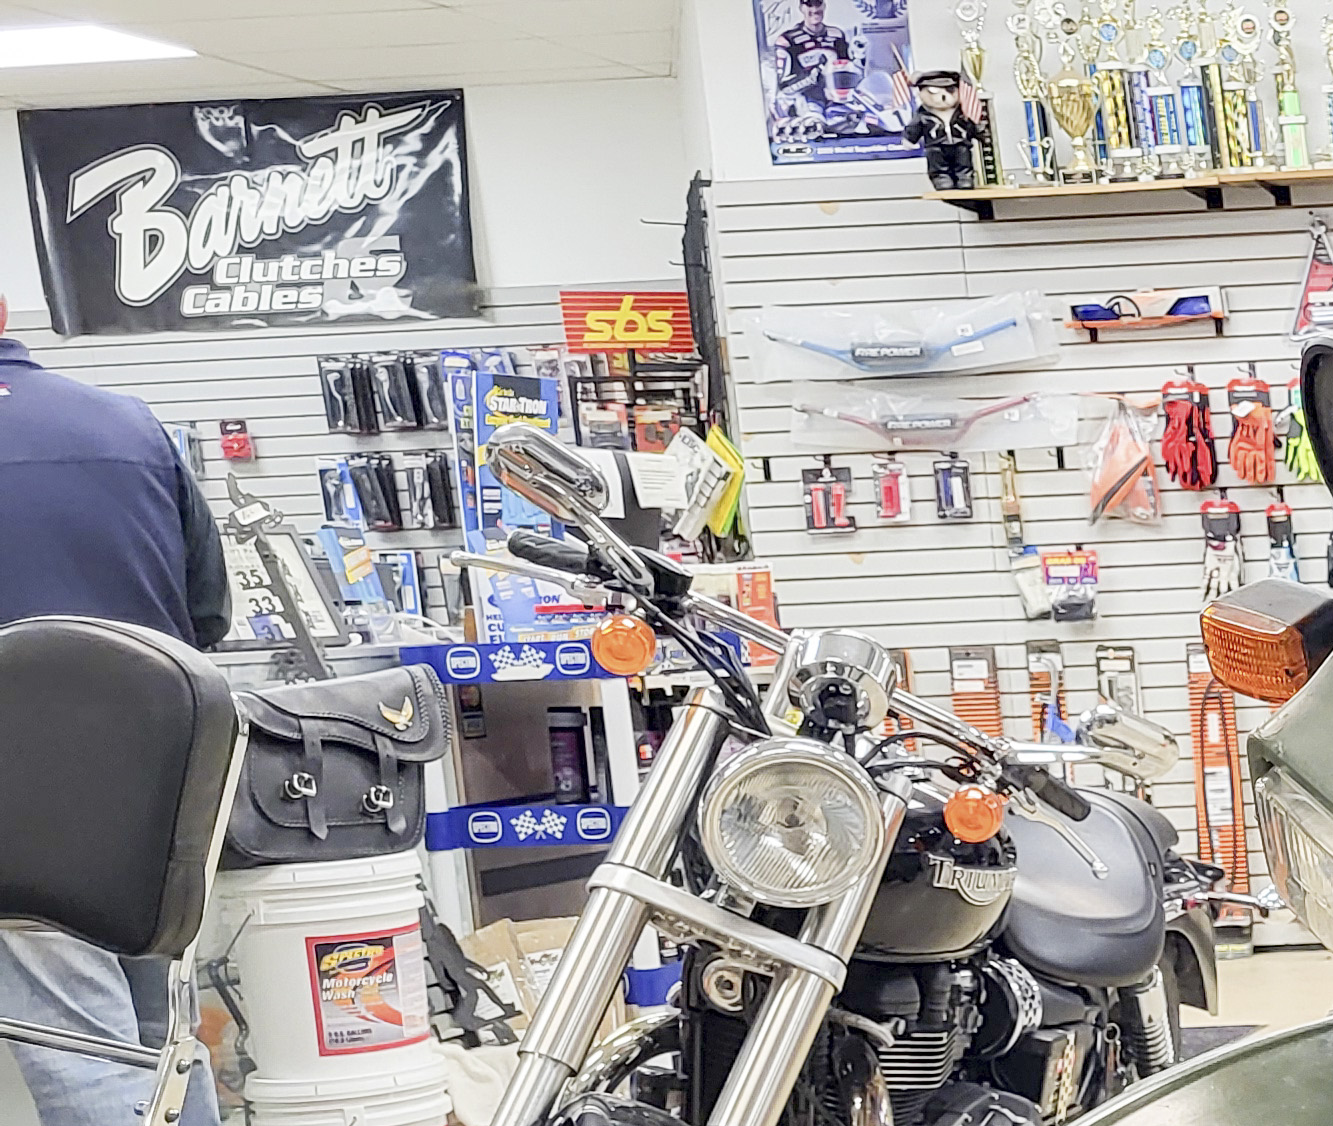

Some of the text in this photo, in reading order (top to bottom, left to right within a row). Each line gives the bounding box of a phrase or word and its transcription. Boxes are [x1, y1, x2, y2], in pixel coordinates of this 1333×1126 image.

[68, 101, 430, 305] Barnett
[214, 251, 406, 285] Clutches
[180, 284, 325, 317] Cables
[583, 295, 674, 342] sbs
[235, 568, 264, 591] 35
[249, 596, 276, 616] 33
[322, 972, 394, 990] Motorcycle
[322, 990, 356, 1002] Wash
